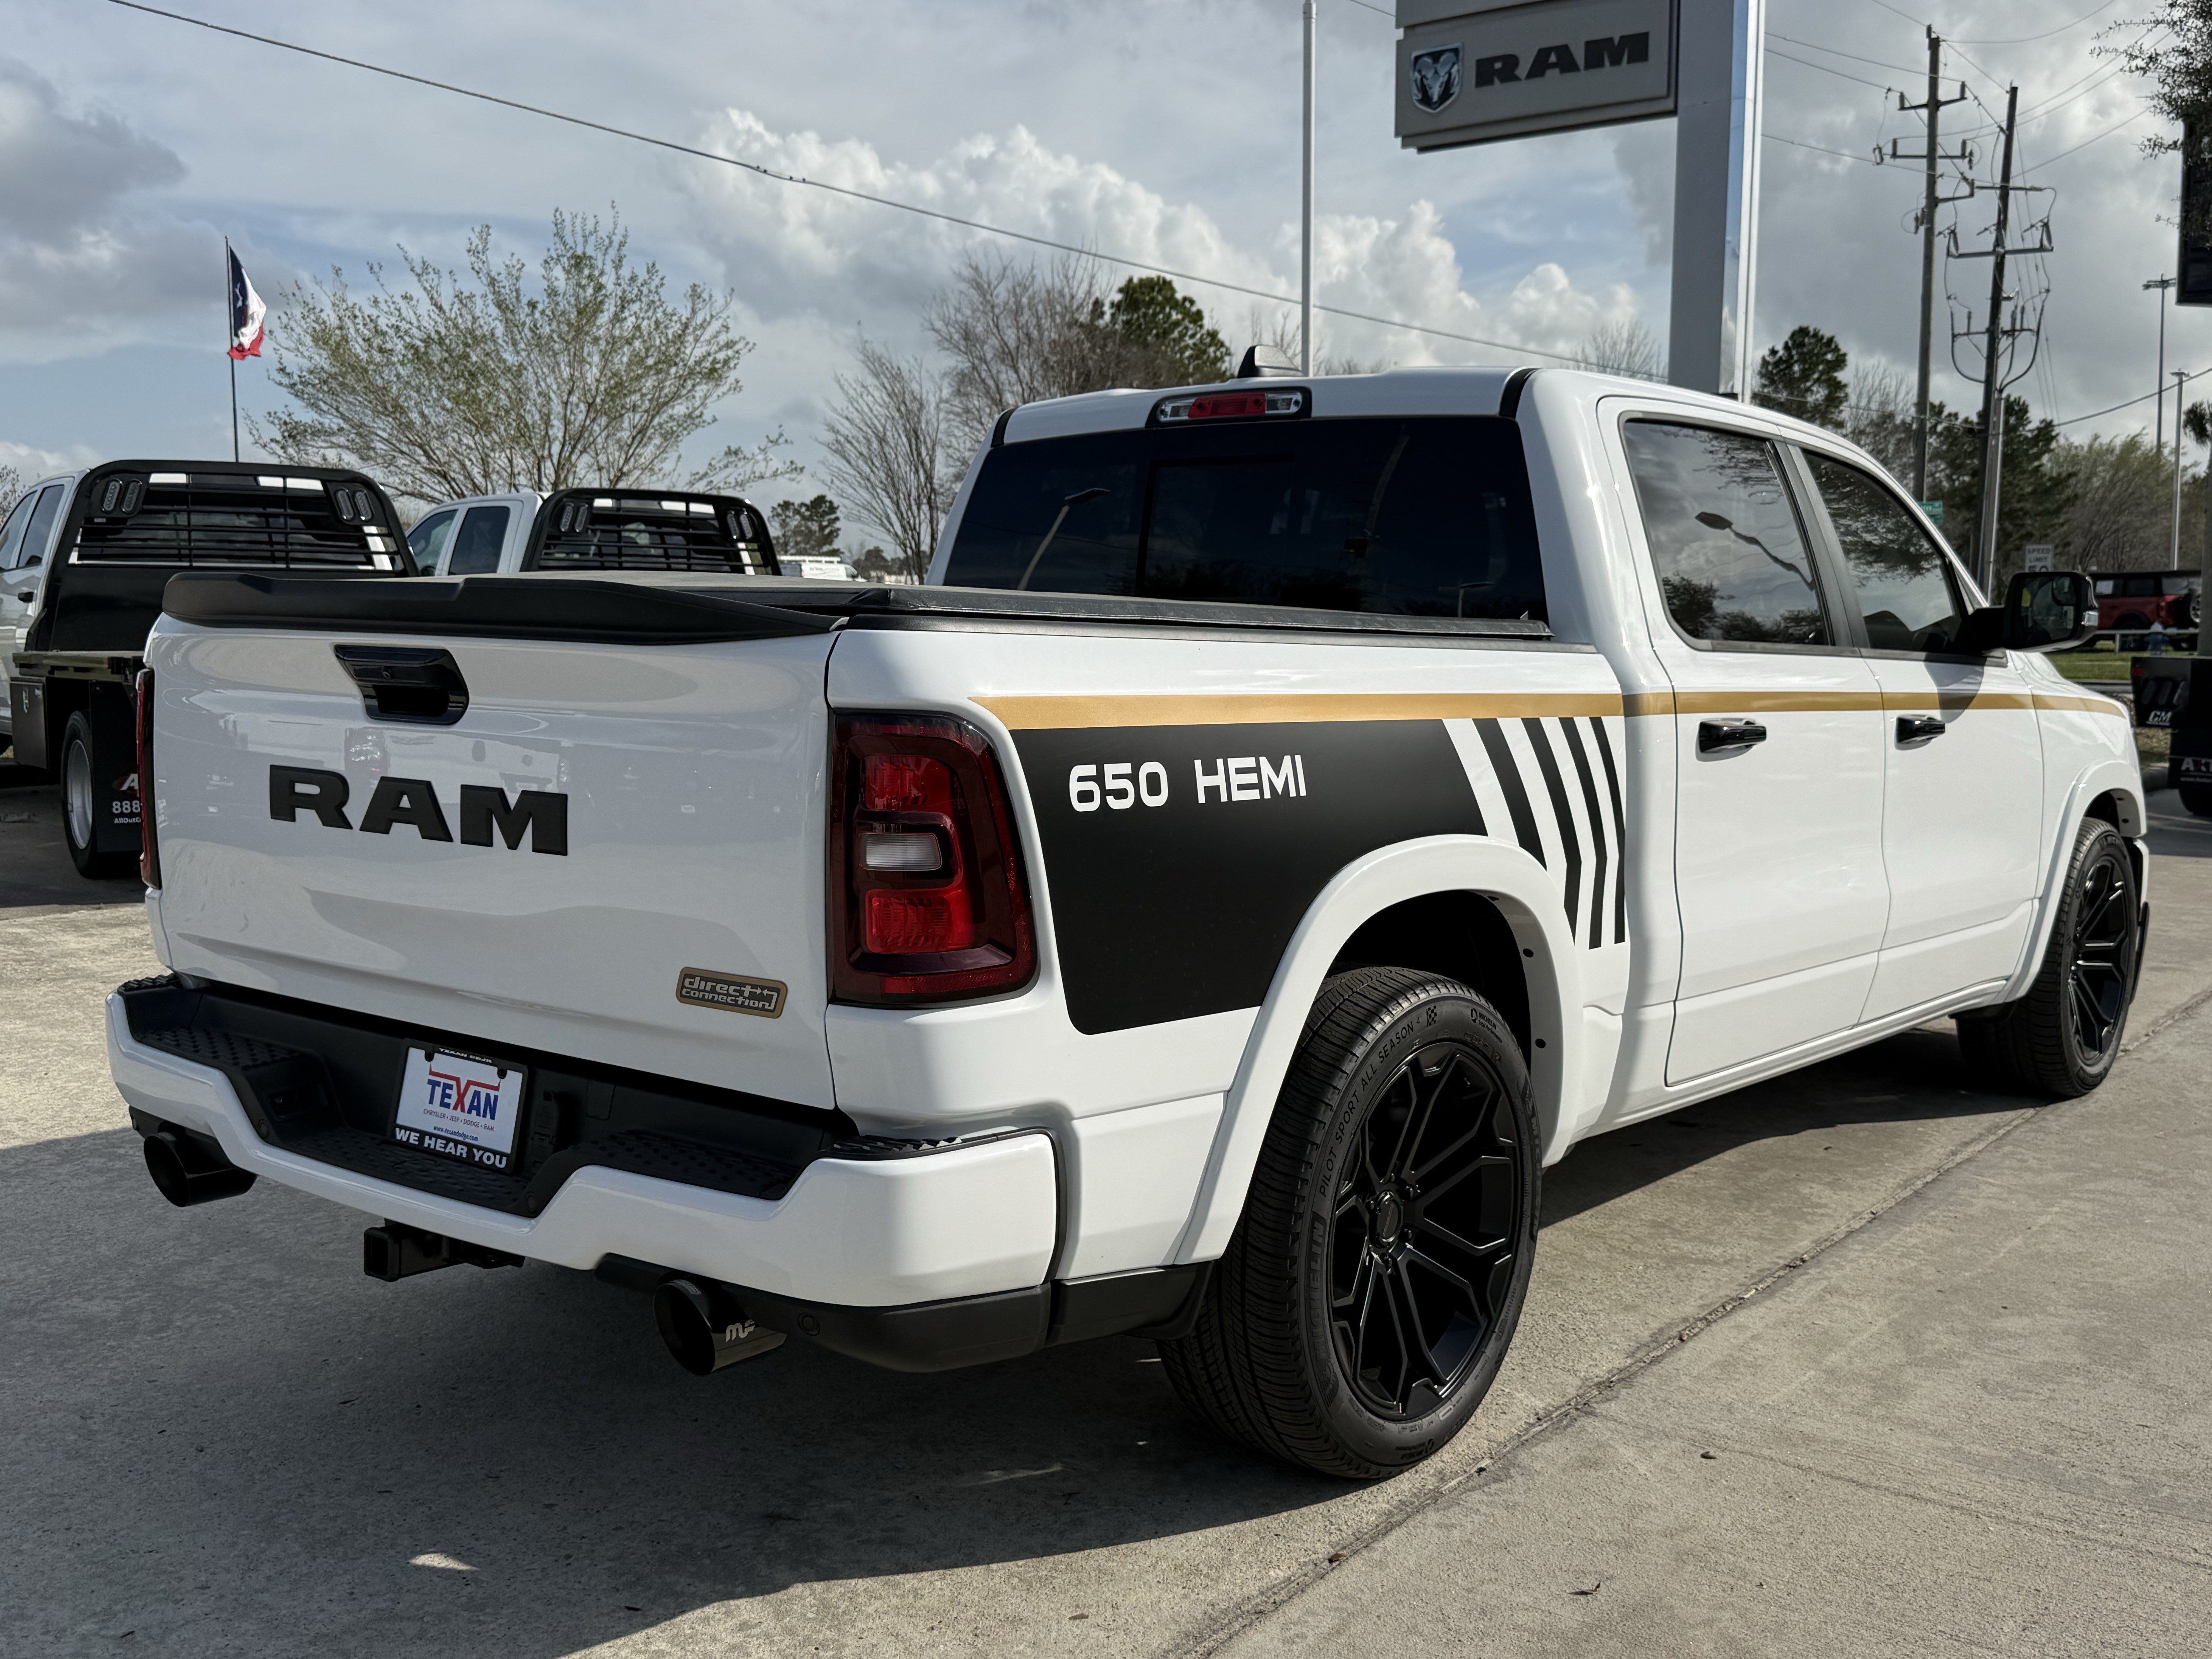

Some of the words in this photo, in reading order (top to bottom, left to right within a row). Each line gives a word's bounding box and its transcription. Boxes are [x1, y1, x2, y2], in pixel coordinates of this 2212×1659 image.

[1474, 31, 1650, 88] RAM
[1069, 761, 1168, 812] 650
[1194, 754, 1306, 804] HEMI
[270, 764, 568, 856] RAM
[682, 988, 771, 1009] connection
[684, 977, 752, 997] direct
[1479, 1012, 1497, 1030] MICHELIN
[439, 1048, 467, 1057] TEXAN
[469, 1055, 492, 1063] CDJR
[427, 1072, 500, 1120] TEXAN
[1319, 1147, 1337, 1197] PILOT
[1335, 1090, 1359, 1144] SPORT
[1361, 1063, 1377, 1092] ALL
[1378, 1021, 1414, 1063] SEASON
[424, 1109, 445, 1119] CHRYSLER
[463, 1119, 480, 1128] DODGE
[433, 1125, 479, 1142] www.texandodge.com
[395, 1127, 420, 1145] WE
[424, 1135, 467, 1158] HEAR
[472, 1148, 507, 1168] YOU
[1310, 1221, 1326, 1361] MICHELIN
